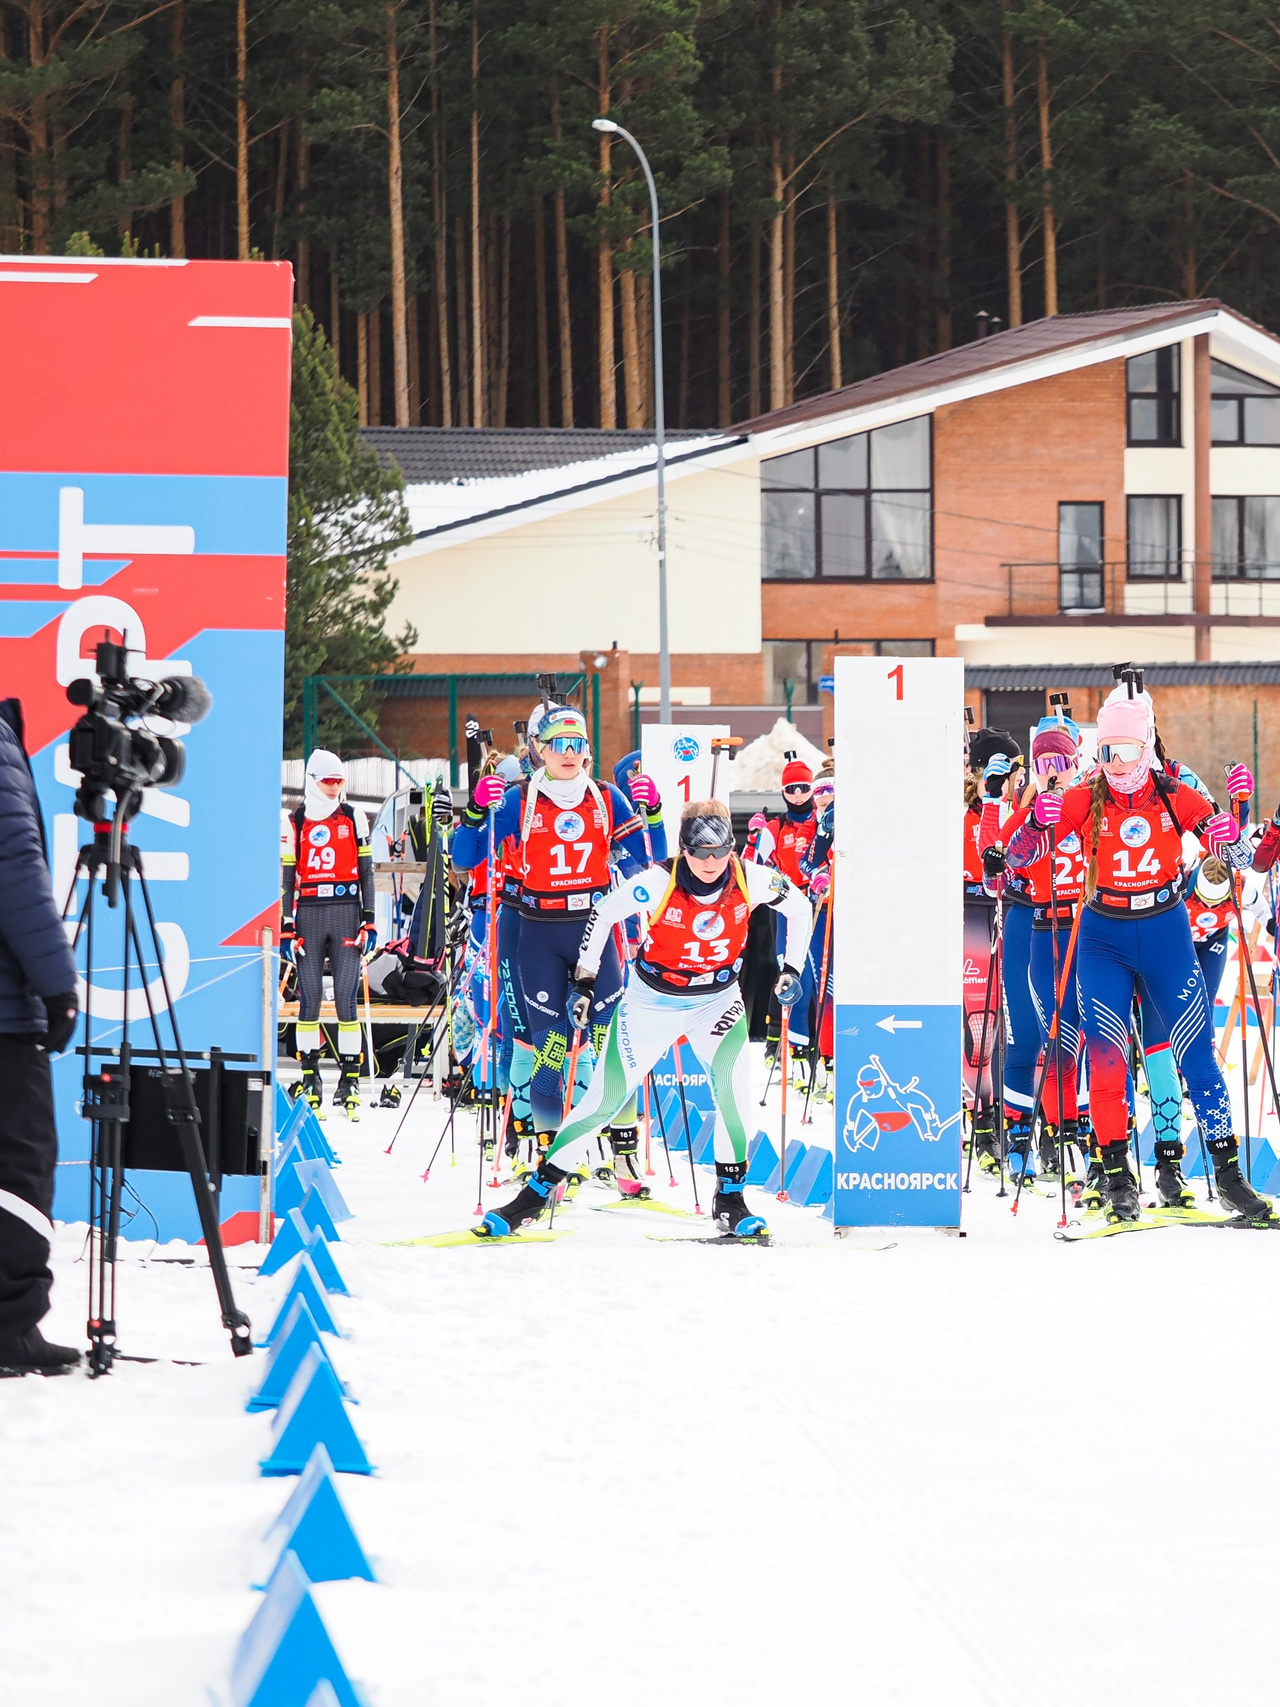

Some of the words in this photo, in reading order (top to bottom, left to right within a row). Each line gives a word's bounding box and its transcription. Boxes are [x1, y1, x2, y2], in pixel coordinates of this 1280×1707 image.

[887, 664, 904, 701] 1
[677, 775, 690, 803] 1
[307, 846, 336, 870] 49
[549, 842, 593, 875] 17
[1112, 848, 1162, 878] 14
[550, 877, 592, 887] КРАСНОЯРСК
[1056, 888, 1081, 896] КРАСНО
[1113, 879, 1159, 888] КРАСНОЯРСК
[680, 938, 731, 963] 13
[1177, 959, 1201, 1001] MOAX
[620, 1021, 637, 1069] ЮГОРИЯ
[650, 1073, 710, 1087] РАСНОЯР
[1215, 1141, 1228, 1149] 164
[837, 1172, 959, 1190] КРАСНОЯРСК
